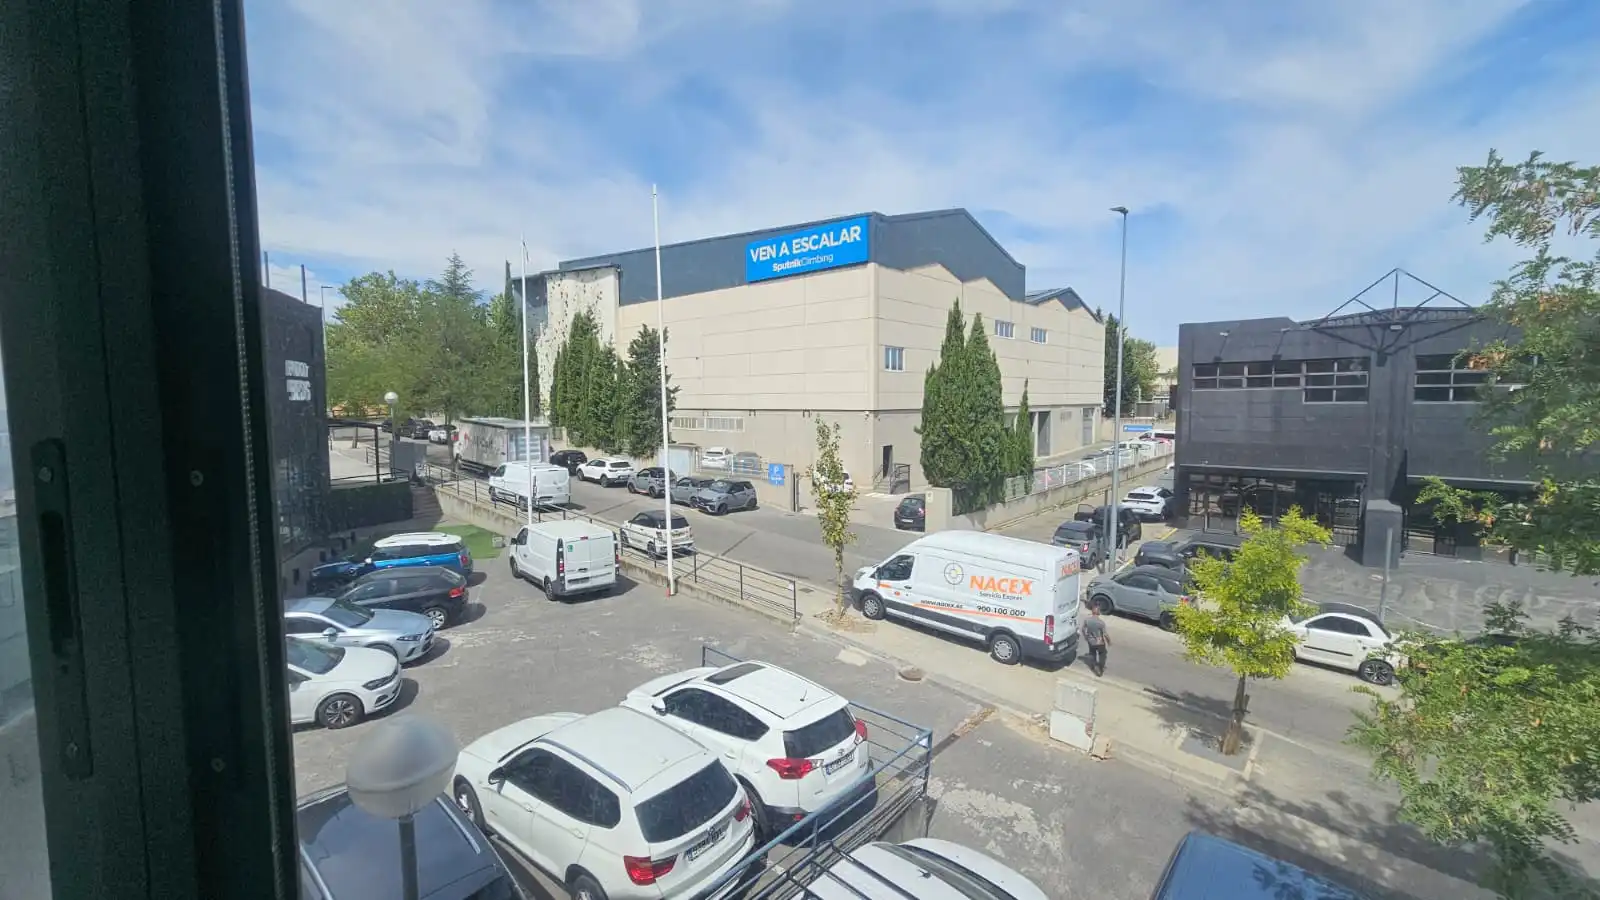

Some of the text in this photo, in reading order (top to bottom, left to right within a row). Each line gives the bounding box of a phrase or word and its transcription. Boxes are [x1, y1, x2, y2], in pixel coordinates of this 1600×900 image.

[750, 225, 861, 263] VEN A ESCALAR
[969, 575, 1033, 596] NACEX
[976, 605, 991, 613] 900
[993, 607, 1008, 615] 100
[1009, 609, 1026, 617] 000
